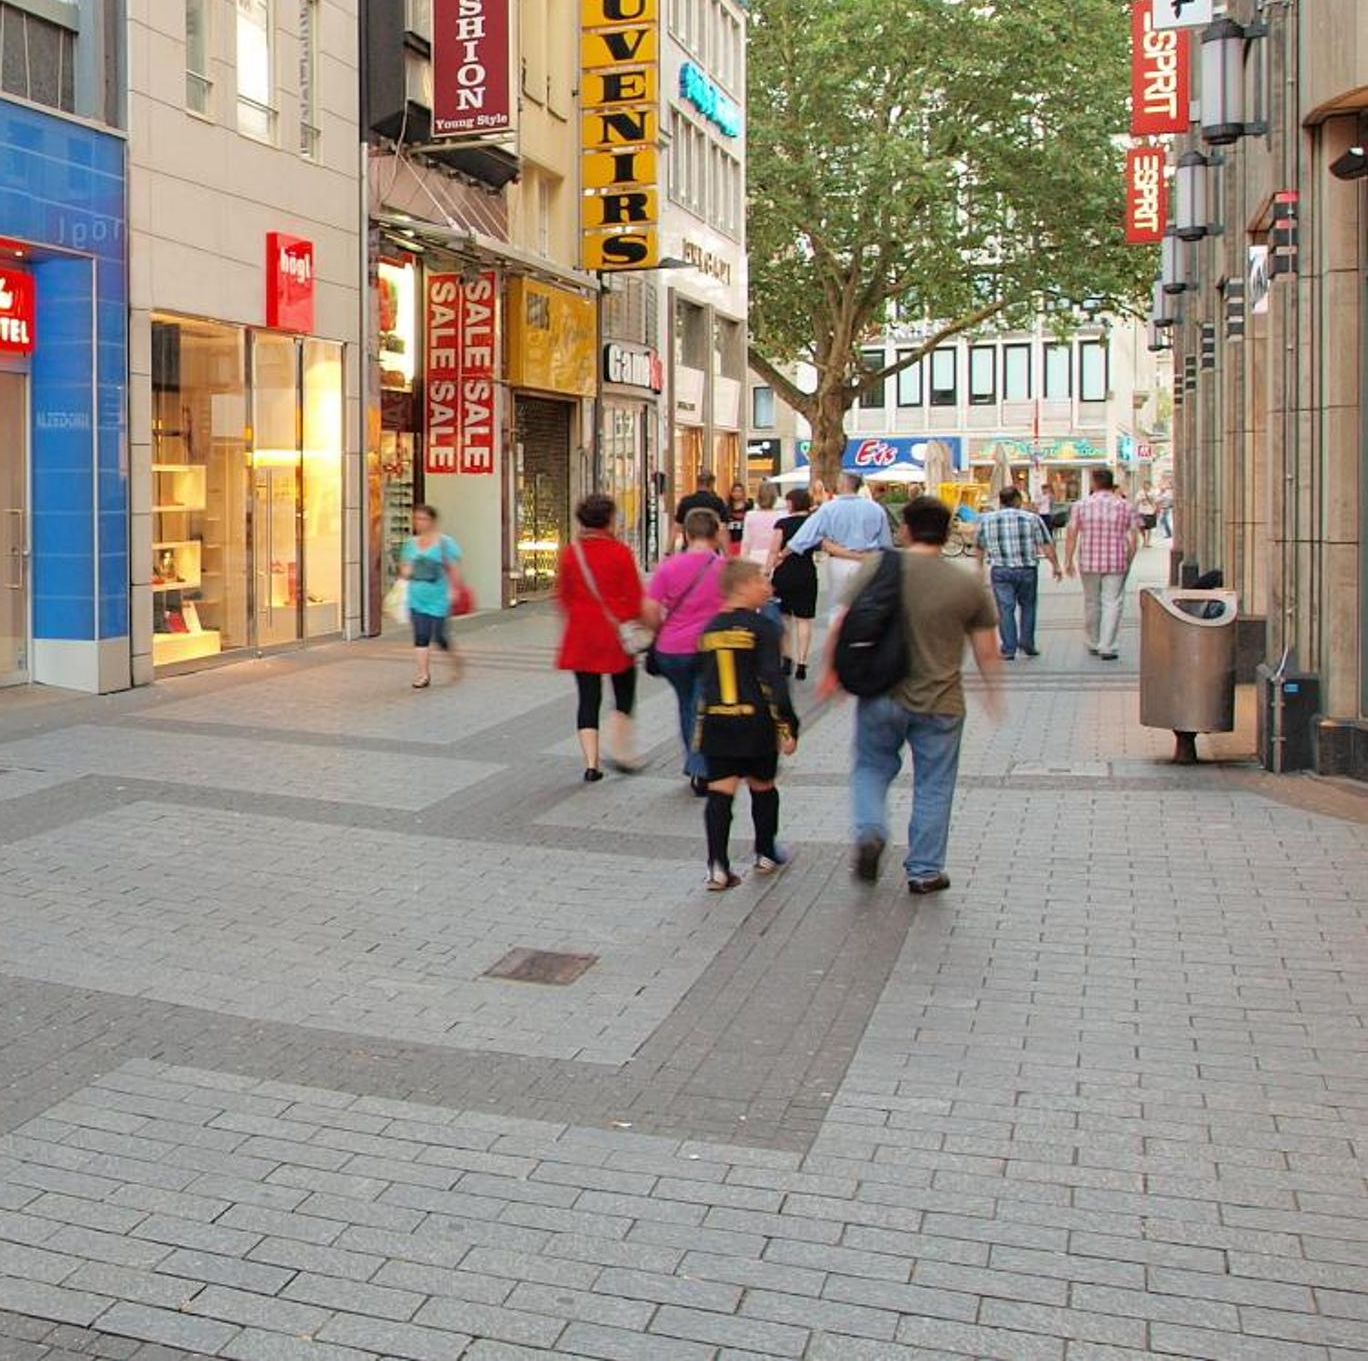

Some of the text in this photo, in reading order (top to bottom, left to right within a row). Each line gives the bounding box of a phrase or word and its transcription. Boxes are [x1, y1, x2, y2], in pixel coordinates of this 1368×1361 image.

[436, 113, 508, 132] Young Style
[1133, 155, 1159, 233] ESPRIT
[429, 281, 457, 468] SALE SALE
[464, 279, 492, 468] SALE SALE
[856, 439, 897, 466] Eis
